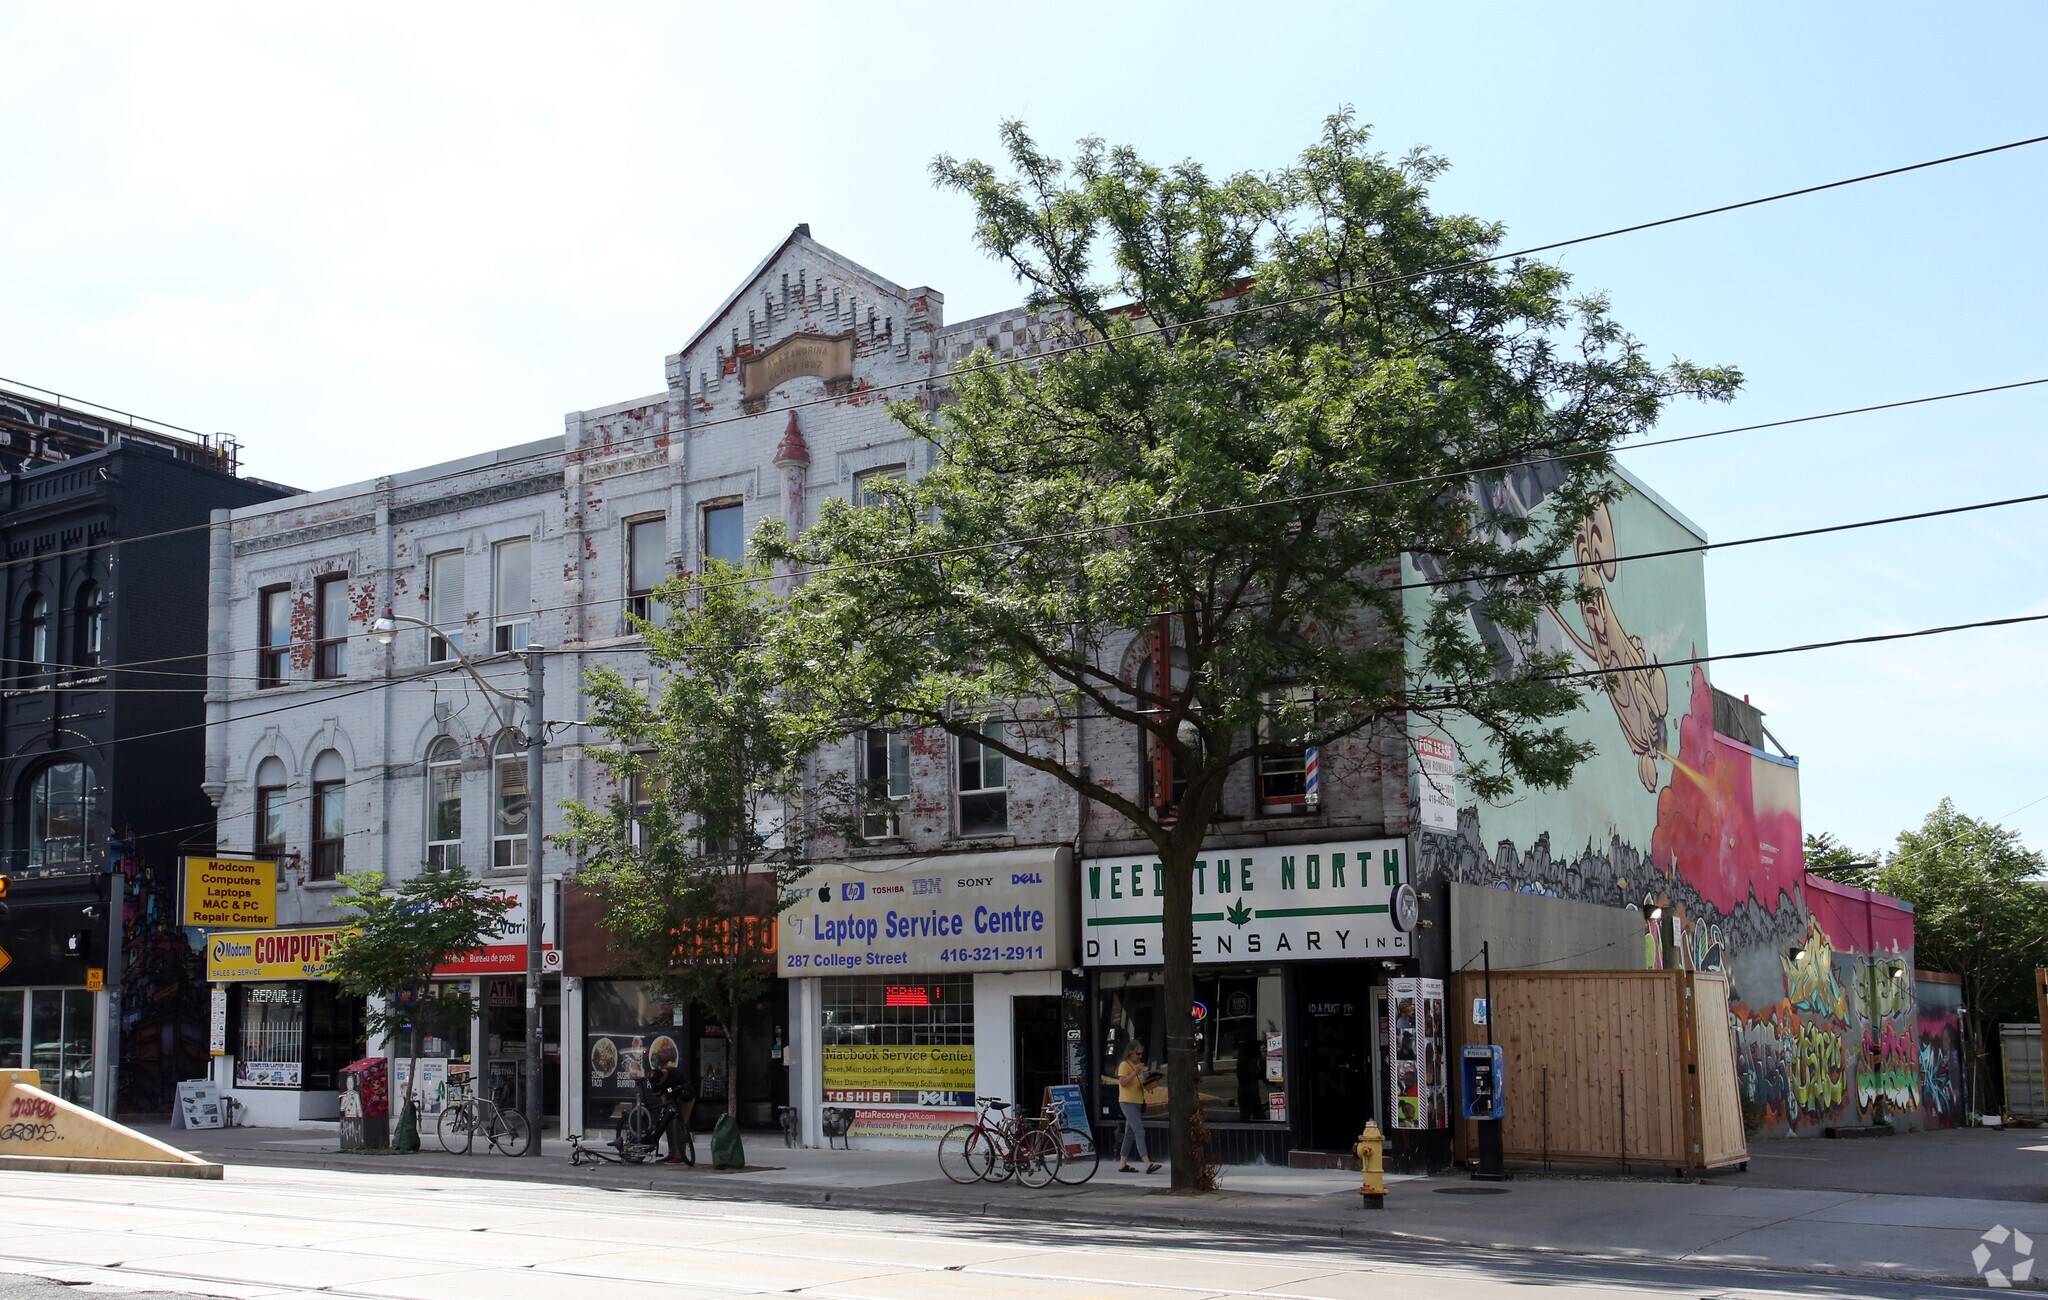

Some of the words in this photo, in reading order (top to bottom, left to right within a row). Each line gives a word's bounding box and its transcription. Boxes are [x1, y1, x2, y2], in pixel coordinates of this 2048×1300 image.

[1420, 739, 1434, 753] FOR
[208, 861, 255, 873] Modcom
[1193, 858, 1254, 895] THE
[1281, 848, 1400, 890] NORTH
[201, 873, 261, 886] Computers
[785, 886, 814, 899] acer
[872, 886, 905, 895] TOSHIBA
[912, 878, 942, 896] IBM
[957, 878, 994, 888] SONY
[1011, 872, 1043, 885] DELL
[208, 886, 252, 899] Laptops
[202, 899, 228, 909] MAC
[232, 900, 240, 910] &
[243, 901, 259, 910] PC
[193, 912, 230, 923] Repair
[232, 913, 268, 923] Center
[814, 912, 878, 946] Laptop
[886, 909, 963, 938] Service
[974, 904, 1044, 934] Centre
[1086, 930, 1350, 958] DISENSARY
[1365, 936, 1406, 948] INC.
[226, 942, 252, 958] Modcom
[470, 954, 490, 962] Bureau
[491, 953, 498, 962] de
[500, 954, 516, 964] poste
[787, 954, 810, 968] 287
[814, 954, 862, 969] College
[866, 952, 908, 965] Street
[940, 946, 1043, 962] 416-321-2911
[91, 972, 99, 980] NO
[212, 968, 230, 977] SALES
[238, 968, 262, 976] SERVICE
[89, 981, 101, 989] EXIT
[490, 981, 516, 998] ATM
[1324, 1002, 1341, 1013] MUST
[1268, 1040, 1280, 1048] 19+
[825, 1048, 880, 1061] Macbook
[882, 1048, 928, 1061] Service
[930, 1049, 974, 1062] Center
[592, 1079, 602, 1088] TACO
[616, 1080, 636, 1088] BURRITO
[954, 1080, 975, 1088] issues
[826, 1091, 892, 1102] TOSHIBA
[918, 1090, 957, 1106] DELL
[1271, 1097, 1284, 1105] OPEN
[854, 1110, 936, 1121] DataRecovery-ON.com
[854, 1120, 864, 1128] We
[866, 1121, 891, 1130] Rescue
[892, 1122, 908, 1130] Files
[909, 1122, 925, 1130] from
[926, 1122, 948, 1130] Failed
